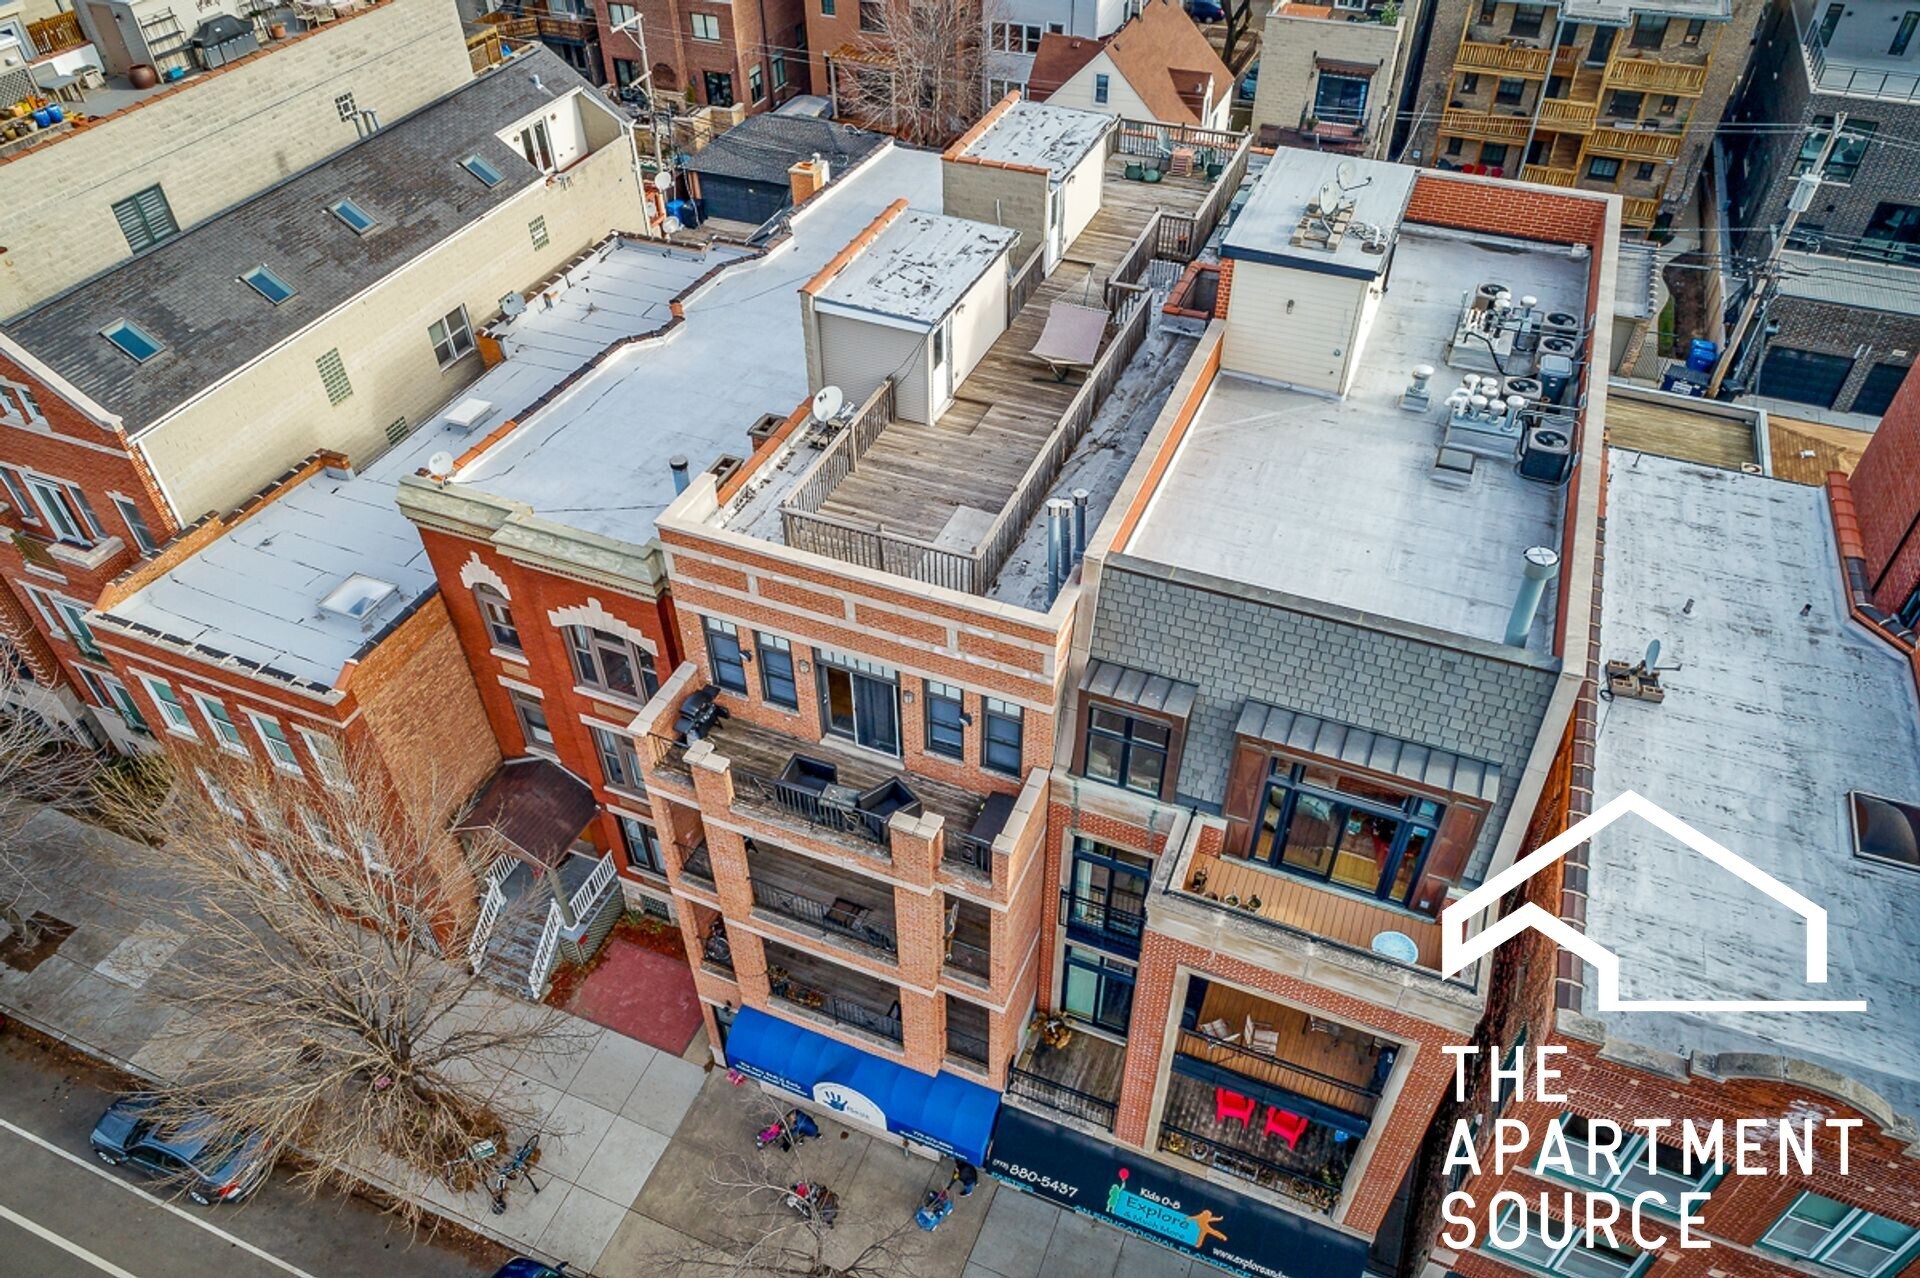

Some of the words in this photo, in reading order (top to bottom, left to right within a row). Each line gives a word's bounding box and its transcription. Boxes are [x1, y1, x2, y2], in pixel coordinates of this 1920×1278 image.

[1009, 1164, 1078, 1198] 880-5437
[1139, 1187, 1160, 1204] Kids
[1126, 1195, 1190, 1230] Explore
[1091, 1211, 1177, 1250] EDUCATIONAL
